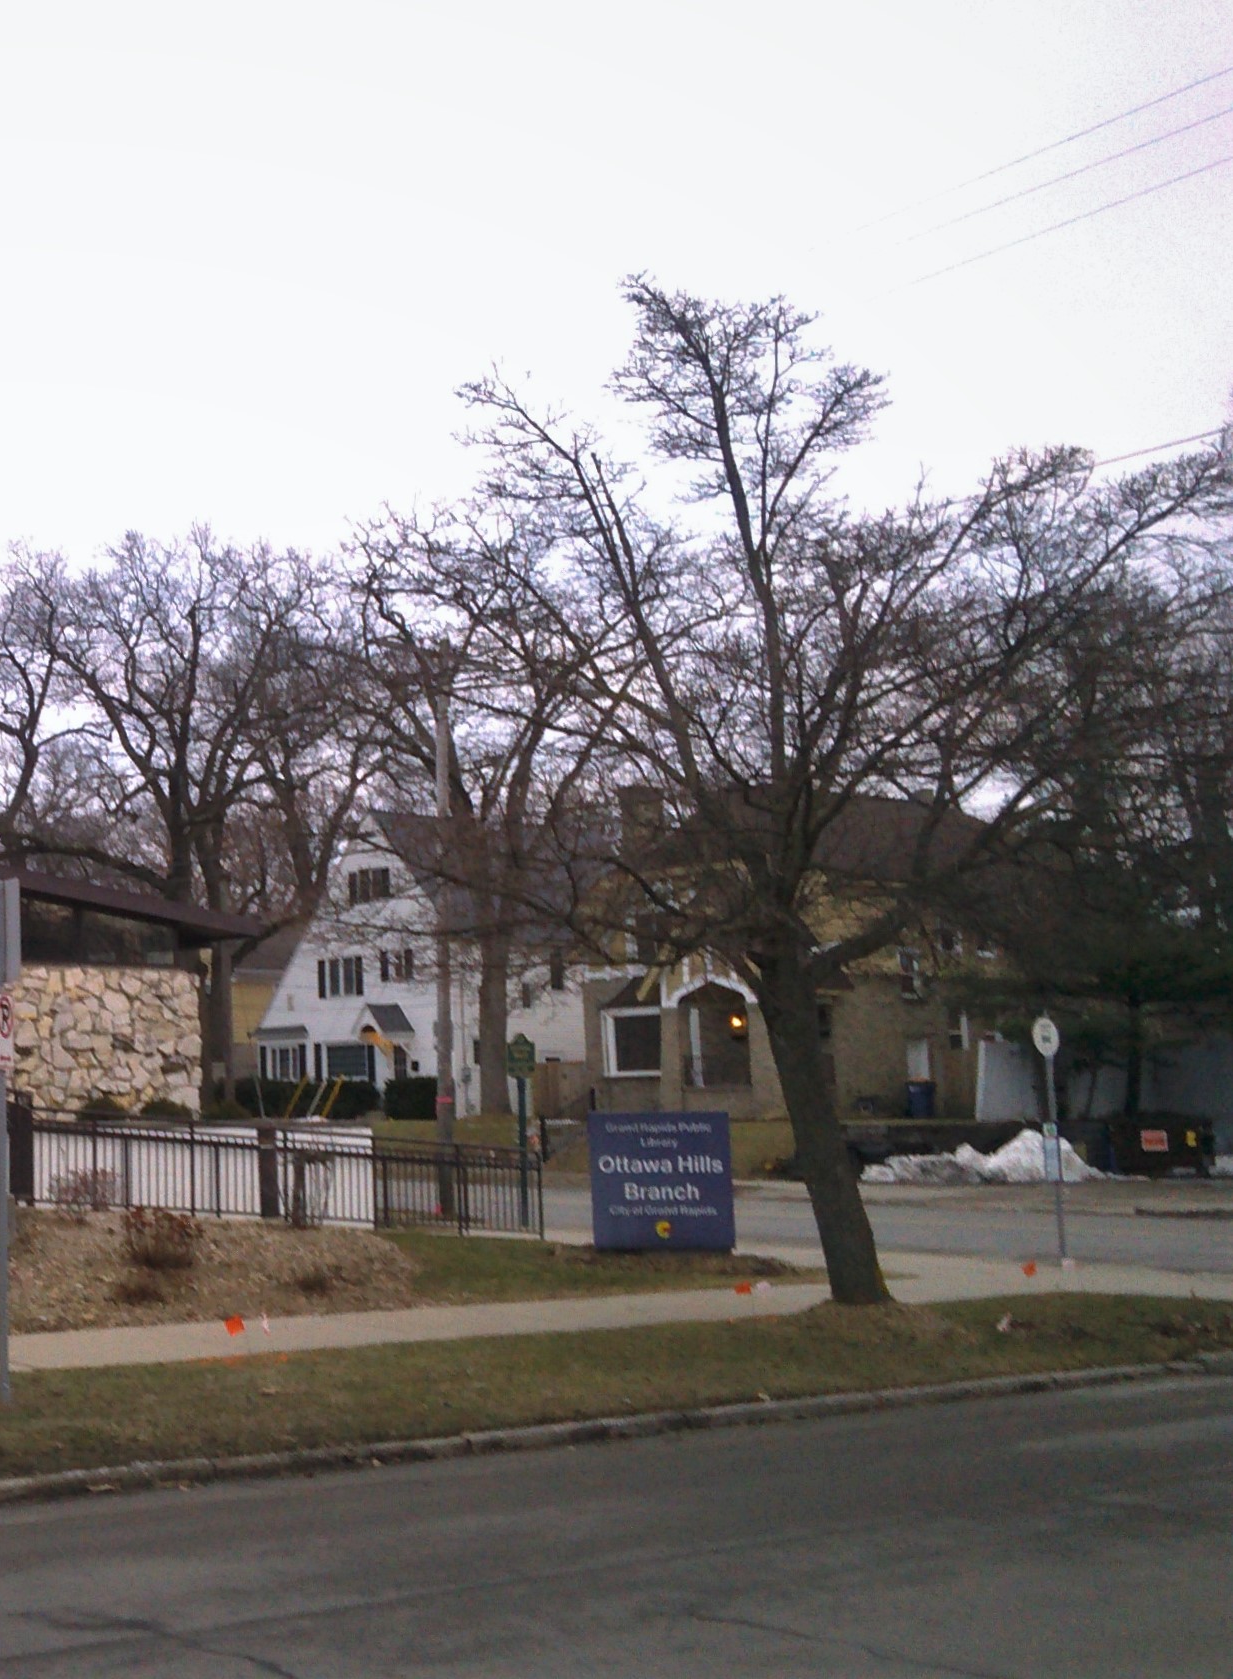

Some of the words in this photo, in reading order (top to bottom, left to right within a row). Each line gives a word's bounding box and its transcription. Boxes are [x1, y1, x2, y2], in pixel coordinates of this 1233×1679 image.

[605, 1122, 639, 1133] Grand
[640, 1122, 677, 1134] Rapids
[678, 1122, 711, 1133] Public
[640, 1137, 678, 1149] Library
[598, 1154, 673, 1174] Ottawa
[677, 1154, 724, 1174] Hills
[623, 1182, 700, 1201] Branch
[609, 1205, 630, 1217] City
[645, 1205, 678, 1216] Grand
[679, 1205, 717, 1217] Rapids
